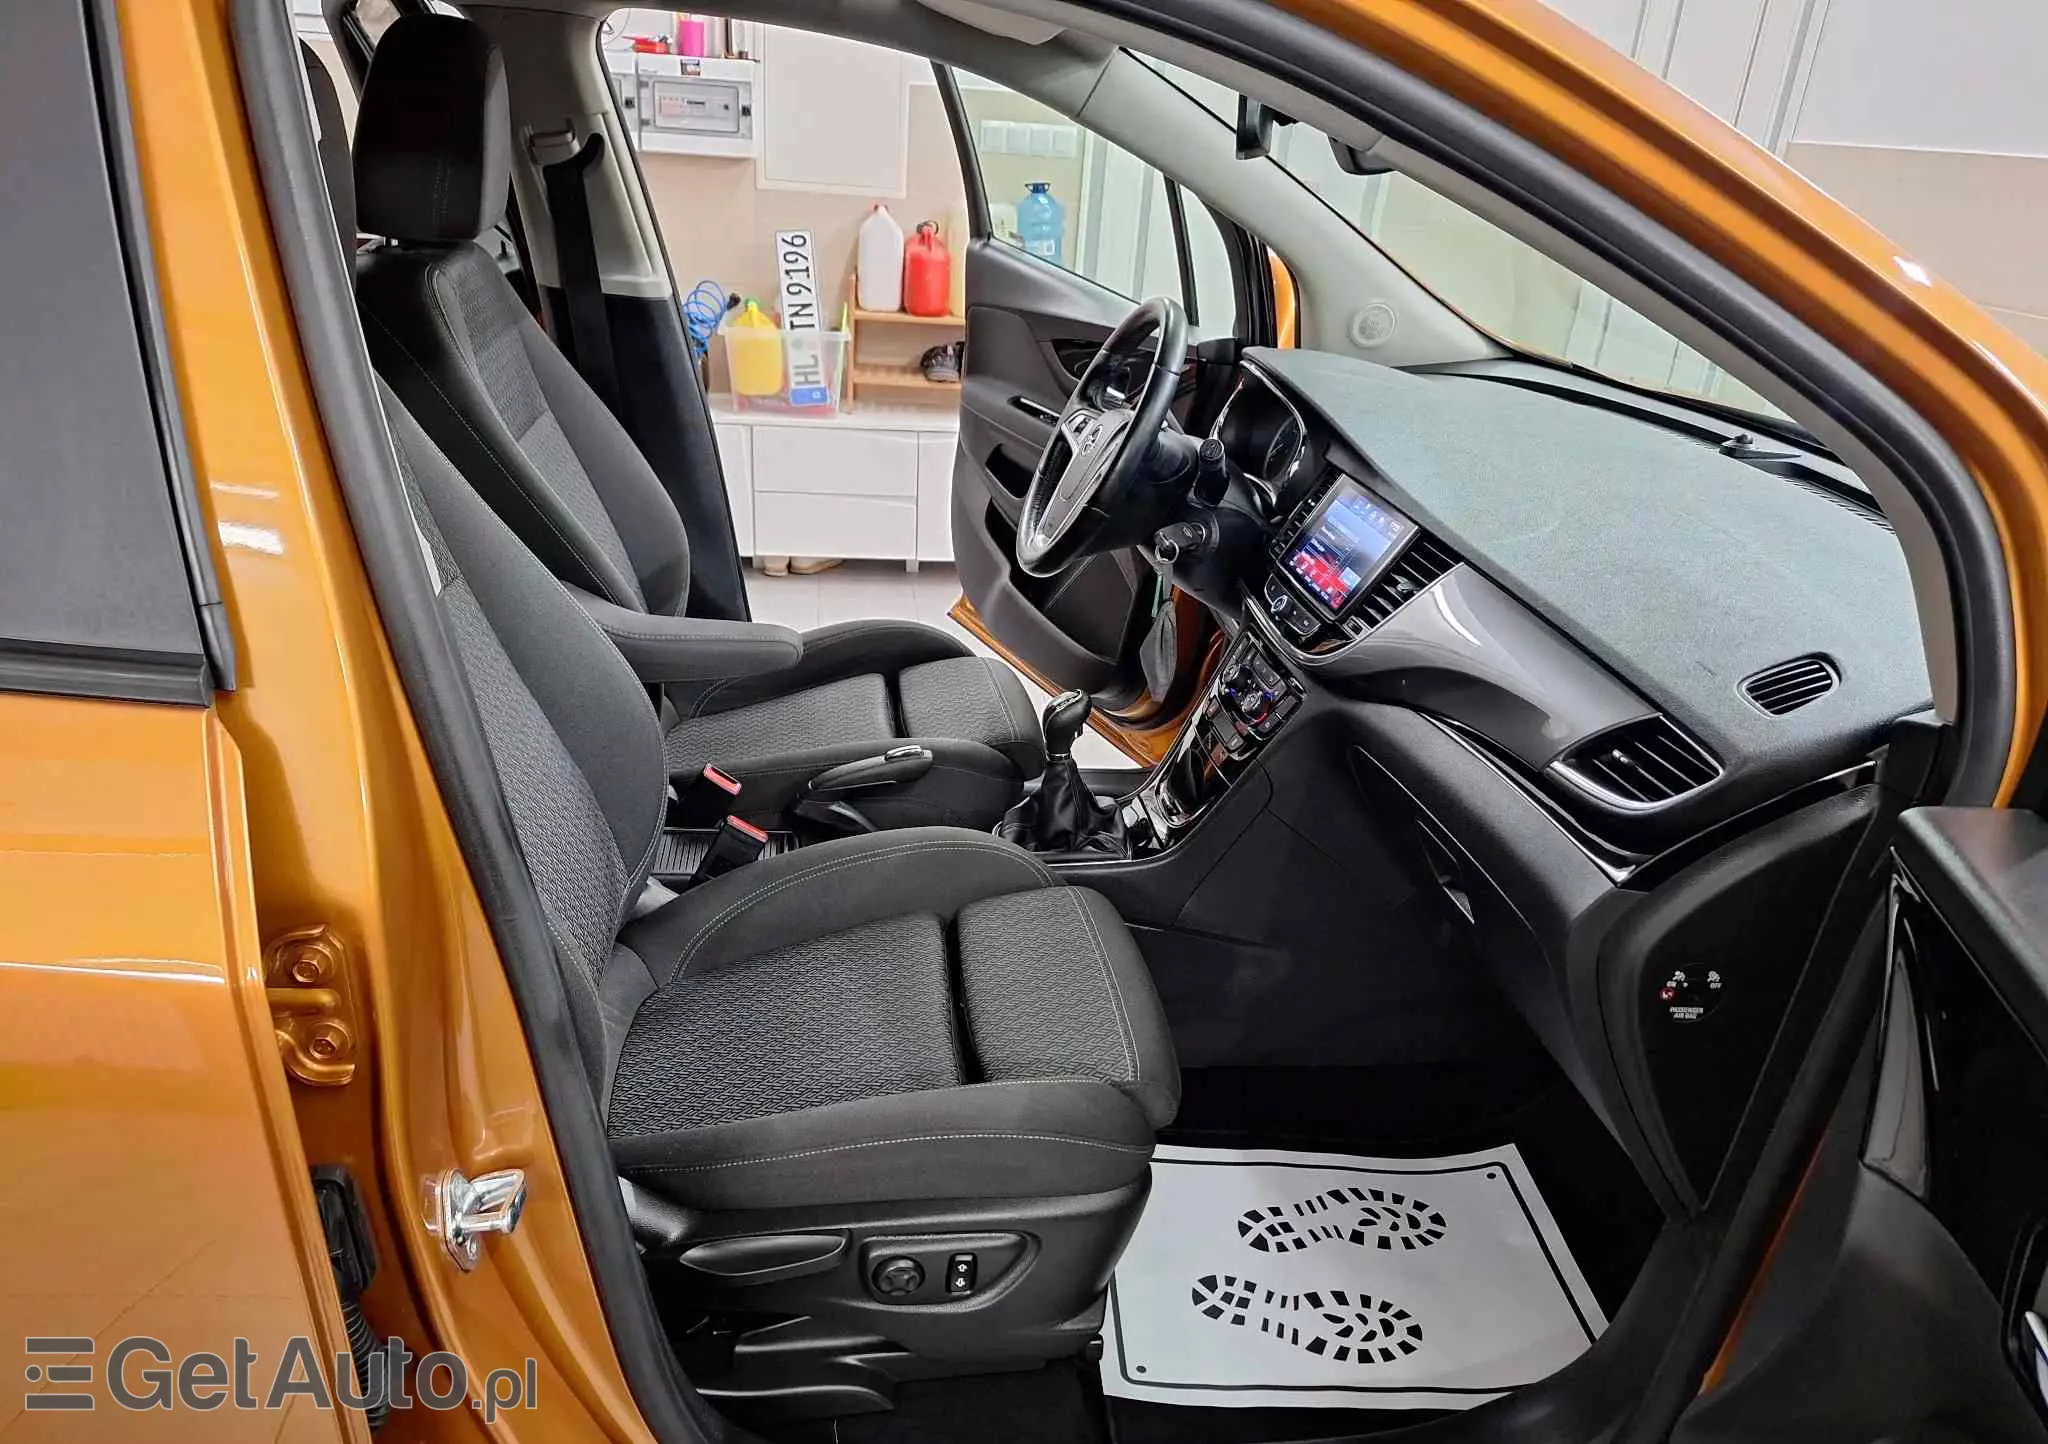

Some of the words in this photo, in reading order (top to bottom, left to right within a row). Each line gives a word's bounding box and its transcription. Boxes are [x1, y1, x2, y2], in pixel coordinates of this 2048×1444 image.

[781, 233, 813, 296] 9196
[787, 303, 816, 331] TN
[794, 354, 820, 386] HL
